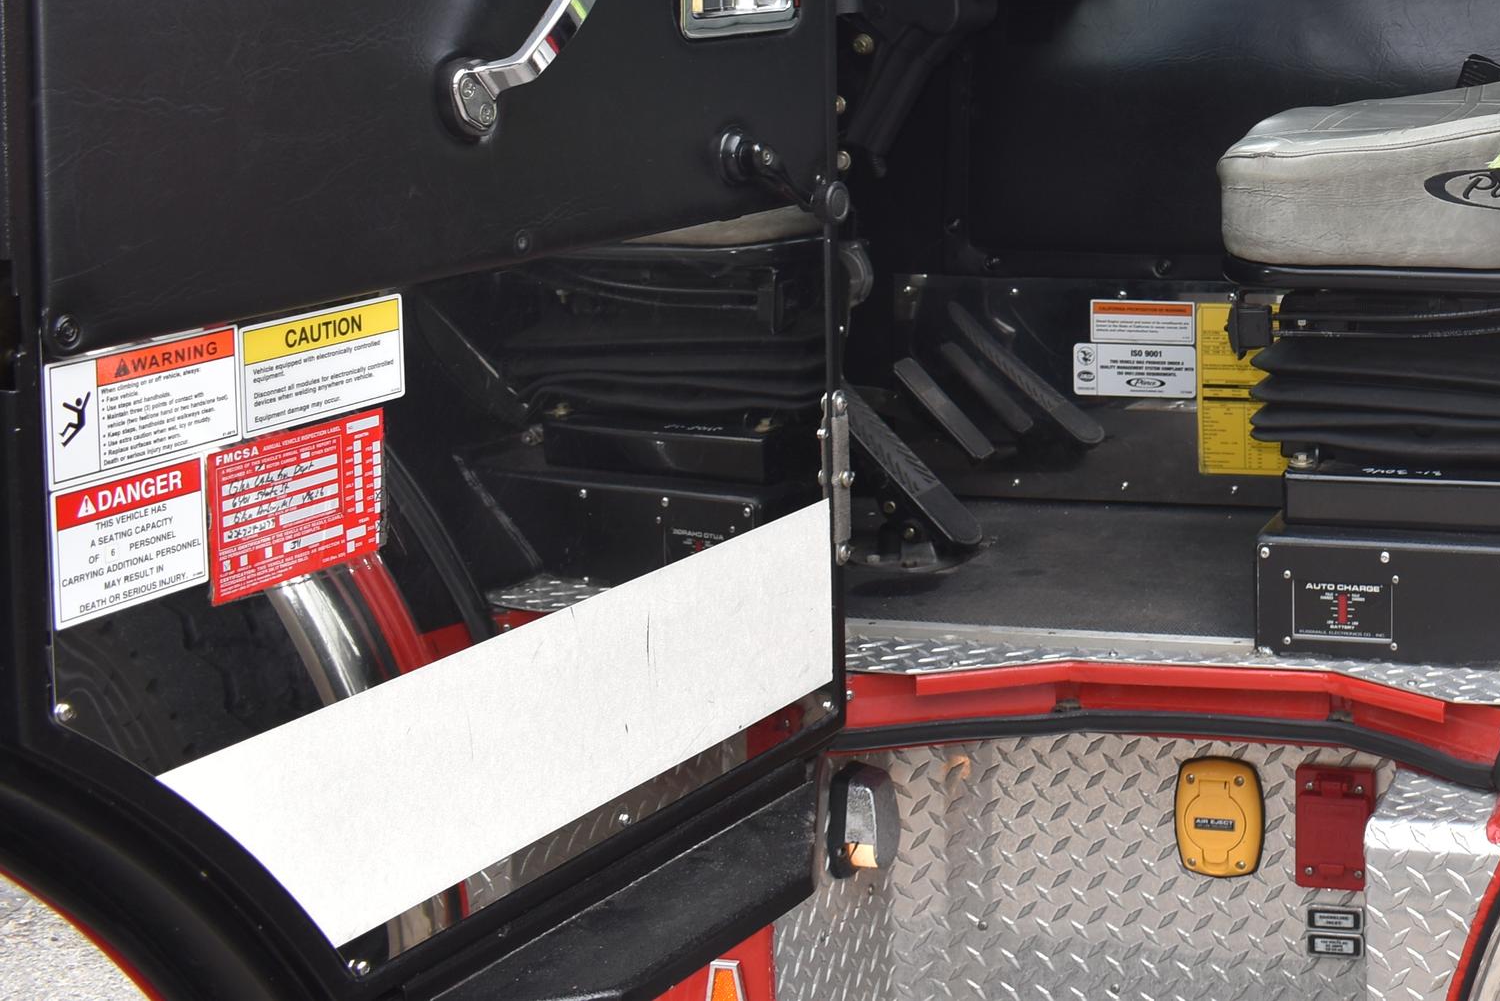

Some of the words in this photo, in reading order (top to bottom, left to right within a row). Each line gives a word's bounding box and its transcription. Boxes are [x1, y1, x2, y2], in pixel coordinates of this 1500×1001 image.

[285, 315, 362, 348] CAUTION
[131, 342, 218, 372] WARNING
[253, 366, 273, 375] Vehicle
[276, 359, 302, 371] equipped
[317, 347, 352, 360] electronically
[354, 340, 380, 351] controlled
[253, 372, 285, 383] equipment.
[254, 386, 286, 399] Disconnect
[296, 378, 320, 388] modules
[331, 366, 366, 380] electronically
[368, 359, 394, 370] controlled
[254, 397, 276, 407] devices
[295, 388, 316, 399] welding
[318, 381, 344, 392] anywhere
[255, 411, 285, 423] Equipment
[288, 404, 309, 415] damage
[104, 458, 119, 466] Death
[216, 446, 259, 466] FMCSA
[98, 470, 183, 512] DANGER
[91, 539, 96, 548] A
[98, 529, 132, 545] SEATING
[135, 516, 174, 534] CAPACITY
[96, 522, 113, 530] THIS
[116, 510, 148, 524] VEHICLE
[151, 503, 167, 513] HAS
[62, 568, 104, 587] CARRYING
[107, 551, 153, 572] ADDITIONAL
[156, 538, 201, 558] PERSONNEL
[89, 554, 100, 564] OF
[129, 531, 176, 551] PERSONNEL
[104, 578, 121, 590] MAY
[124, 567, 154, 583] RESULT
[156, 564, 164, 572] IN
[80, 598, 106, 613] DEATH
[109, 594, 121, 603] OR
[123, 581, 157, 599] SERIOUS
[159, 573, 188, 587] INJURY.
